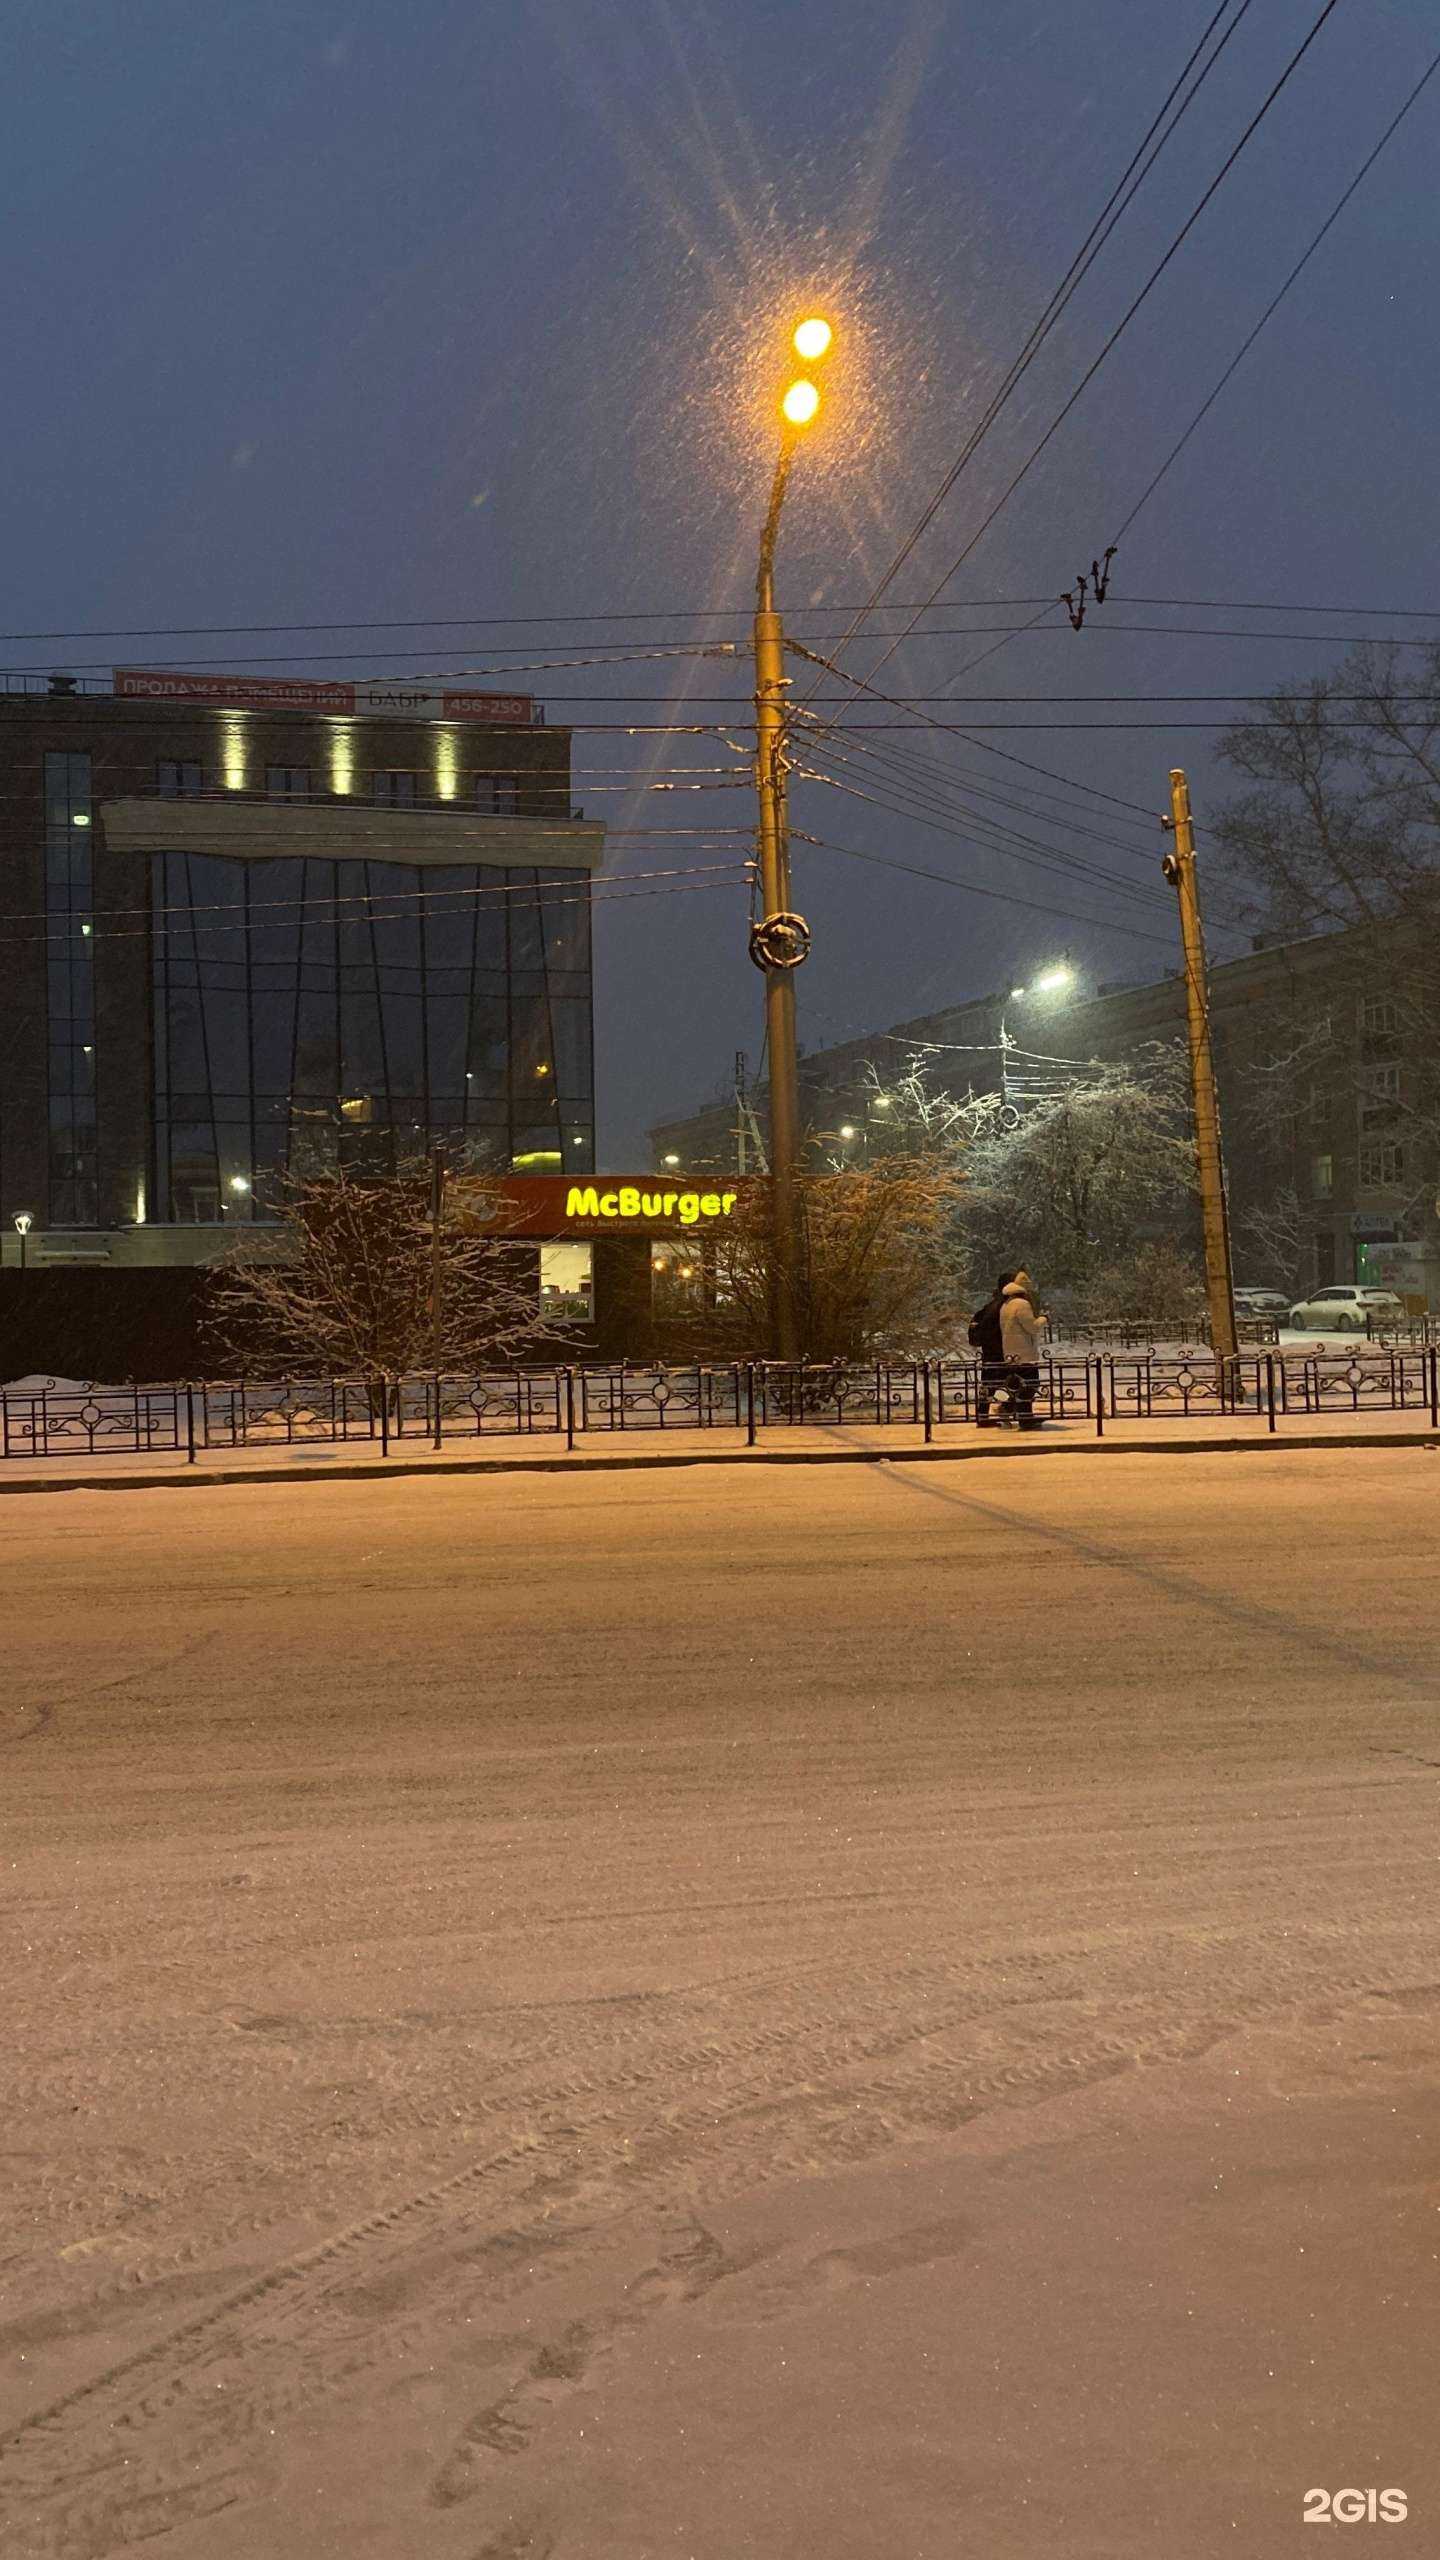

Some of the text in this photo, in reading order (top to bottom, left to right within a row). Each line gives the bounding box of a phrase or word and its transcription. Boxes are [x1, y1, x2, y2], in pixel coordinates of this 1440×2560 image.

[123, 679, 219, 697] ПРОДАЖА
[369, 689, 431, 708] БАБР
[449, 698, 522, 714] 456-250
[566, 1186, 737, 1224] McBurger
